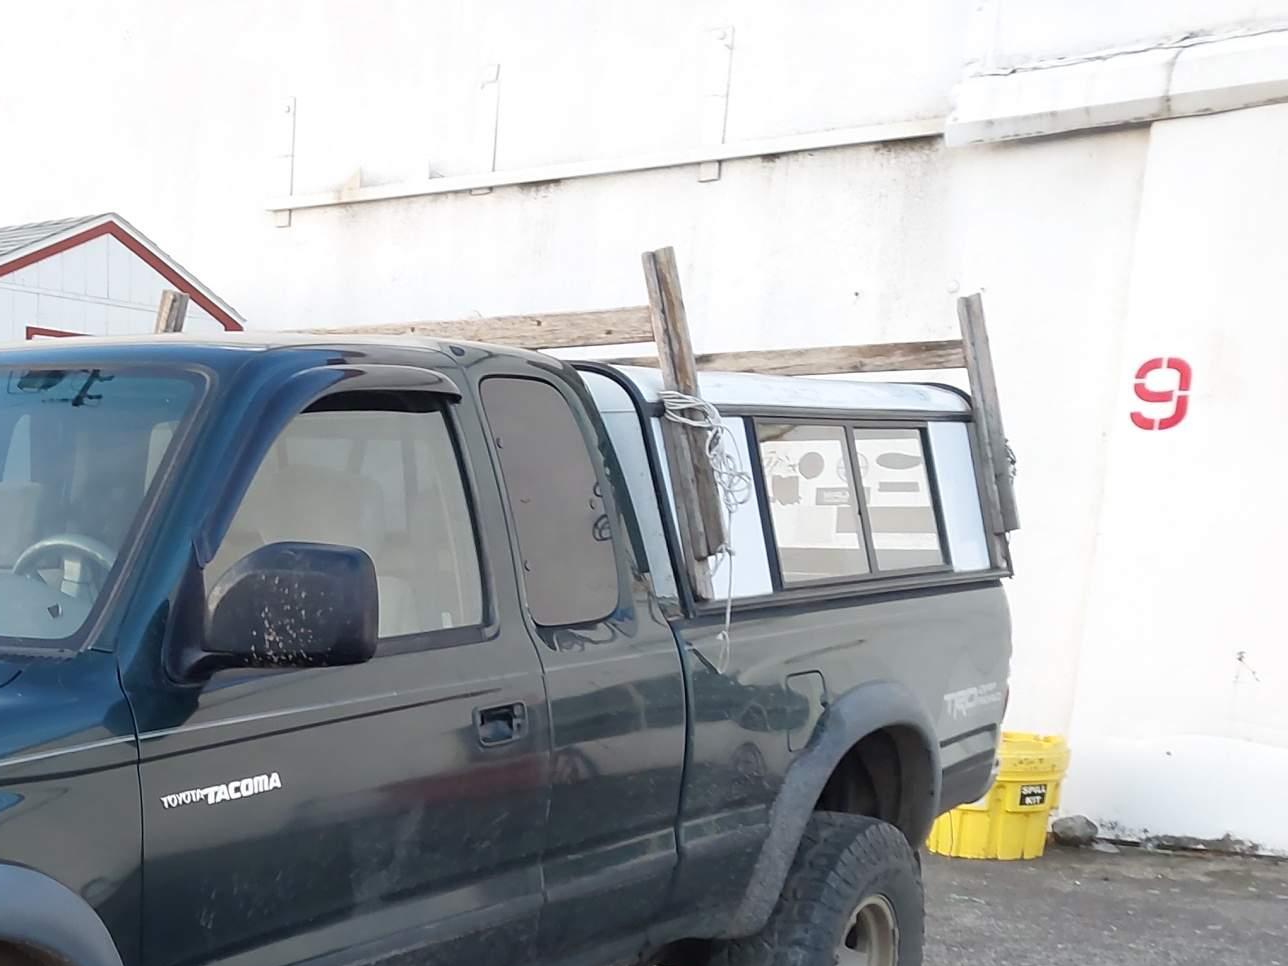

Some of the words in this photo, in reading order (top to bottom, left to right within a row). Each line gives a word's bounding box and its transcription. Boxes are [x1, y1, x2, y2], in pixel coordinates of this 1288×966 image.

[1130, 357, 1192, 431] 9
[160, 788, 204, 809] TOYOTA
[201, 772, 282, 805] TACOMA
[1022, 784, 1047, 795] SPILL
[1024, 795, 1042, 805] KIT
